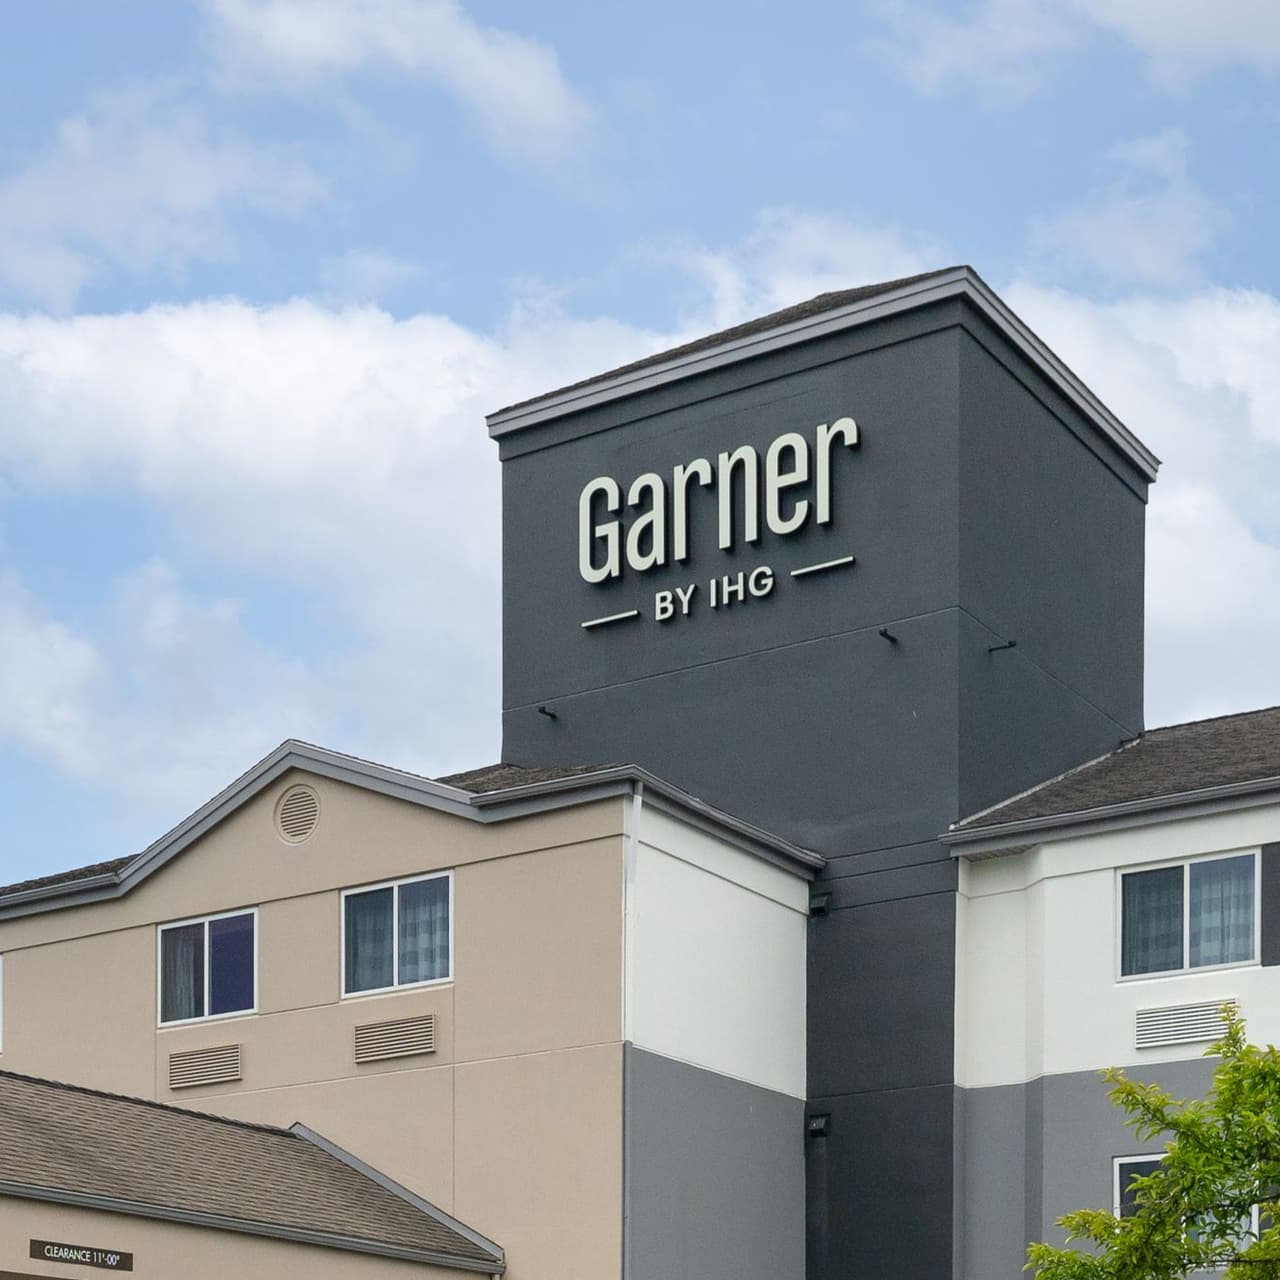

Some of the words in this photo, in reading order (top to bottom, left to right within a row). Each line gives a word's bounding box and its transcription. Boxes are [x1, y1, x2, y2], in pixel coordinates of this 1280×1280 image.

[579, 416, 860, 584] Garner
[655, 584, 696, 621] BY
[710, 566, 775, 608] IHG
[44, 1245, 91, 1262] CLEARANCE
